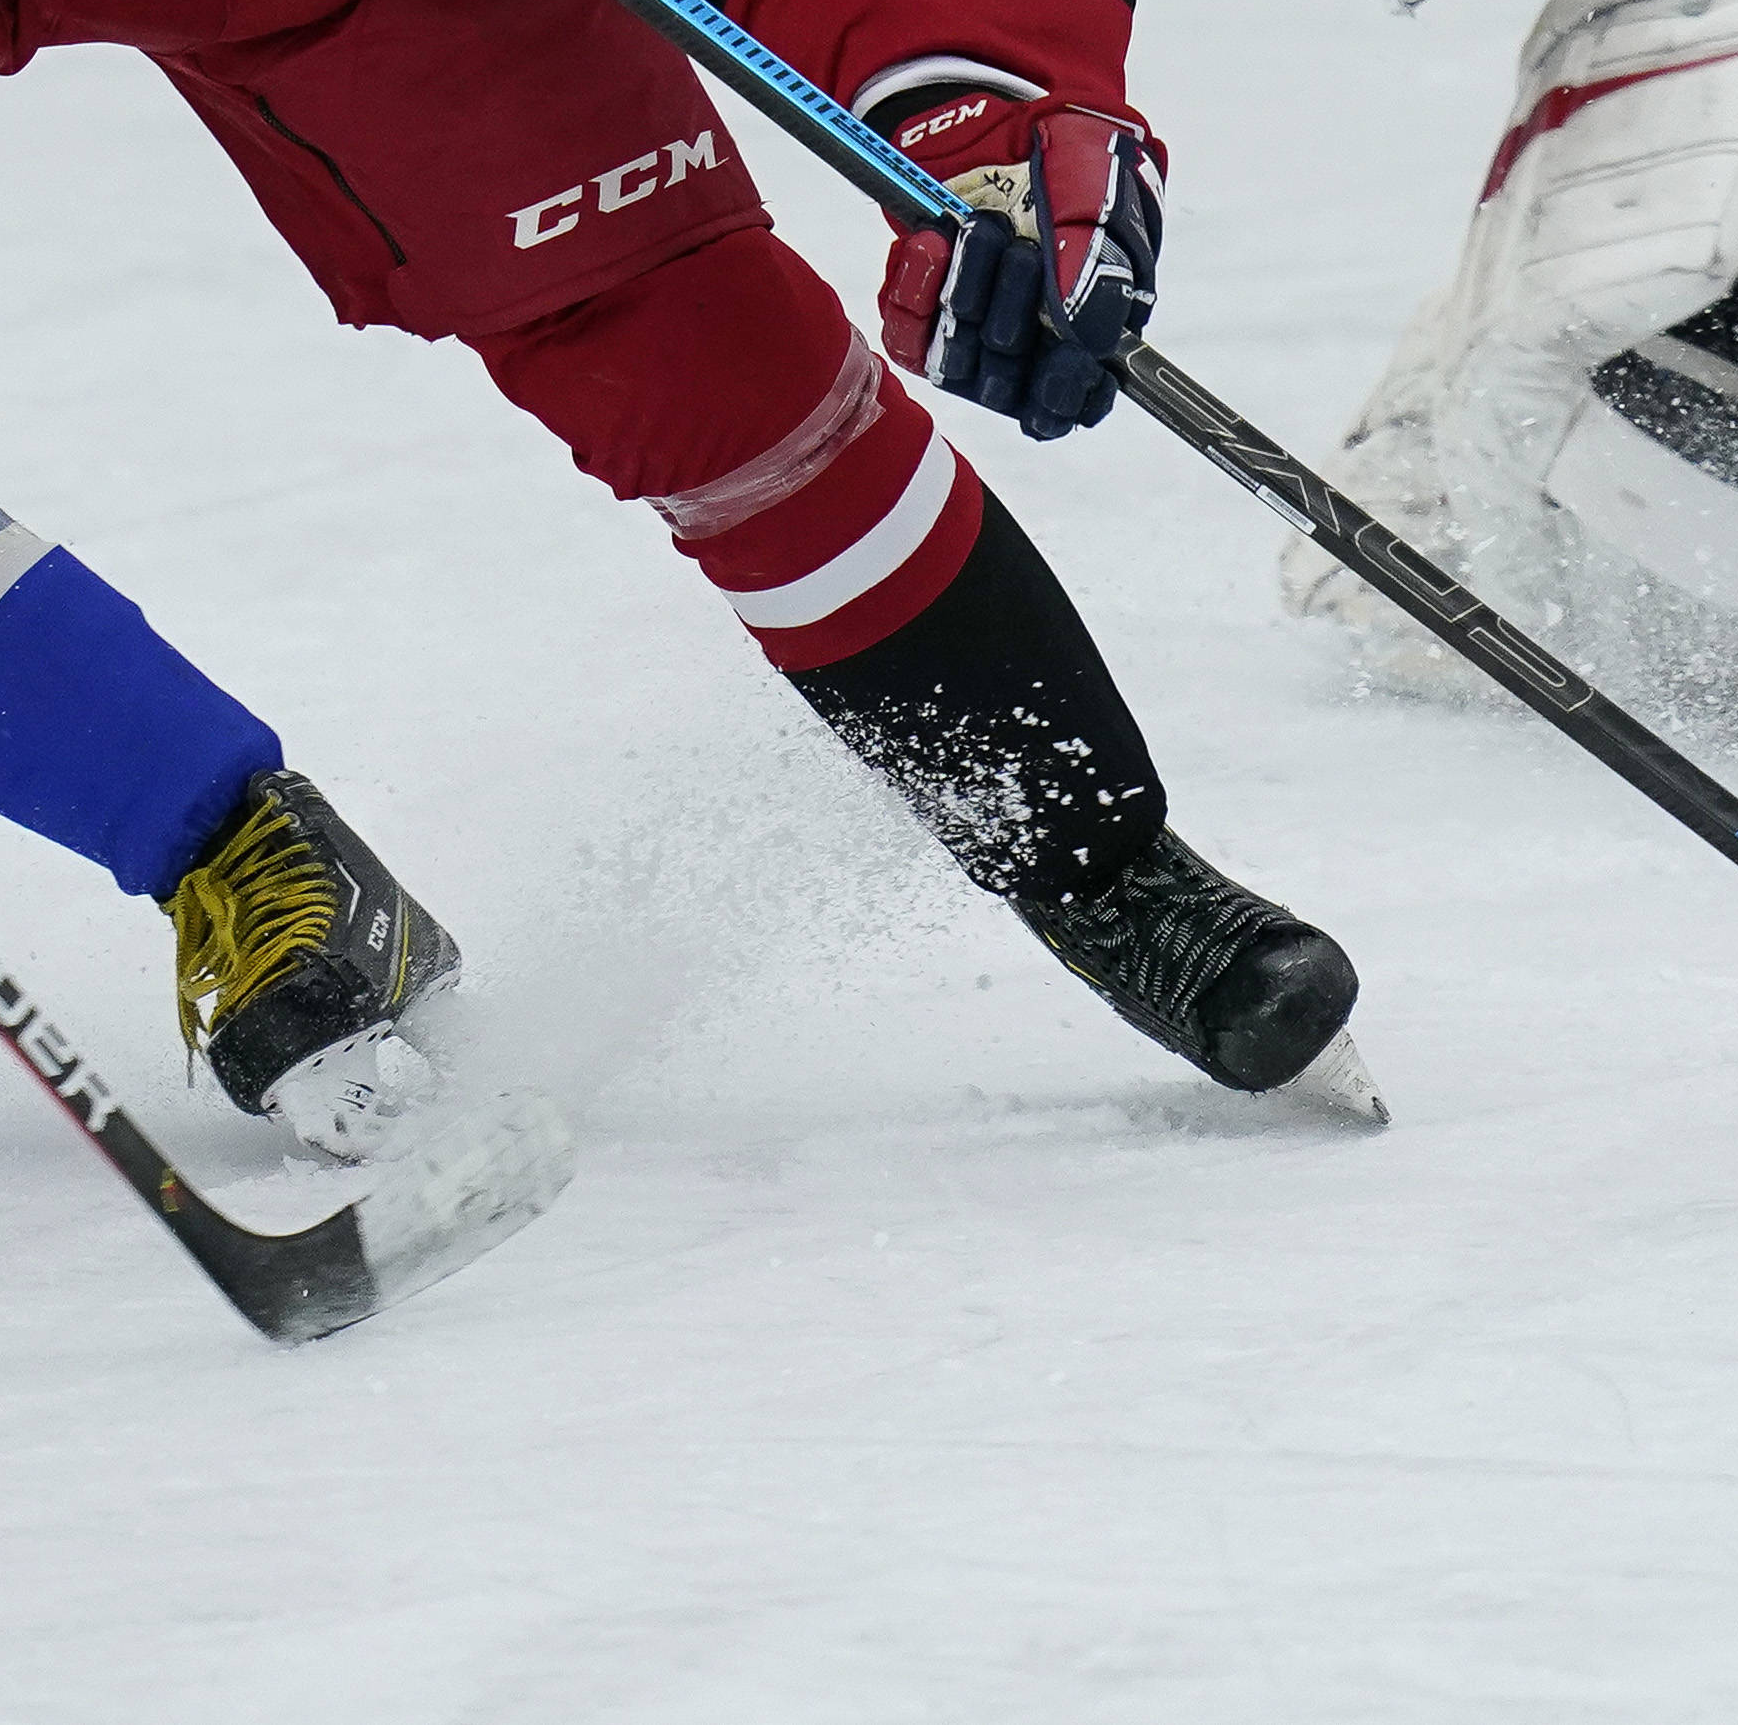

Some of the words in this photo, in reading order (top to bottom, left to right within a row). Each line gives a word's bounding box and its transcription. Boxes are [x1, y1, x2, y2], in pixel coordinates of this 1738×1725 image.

[901, 99, 988, 149] CCM
[506, 130, 730, 251] CCM
[367, 908, 391, 952] CCM
